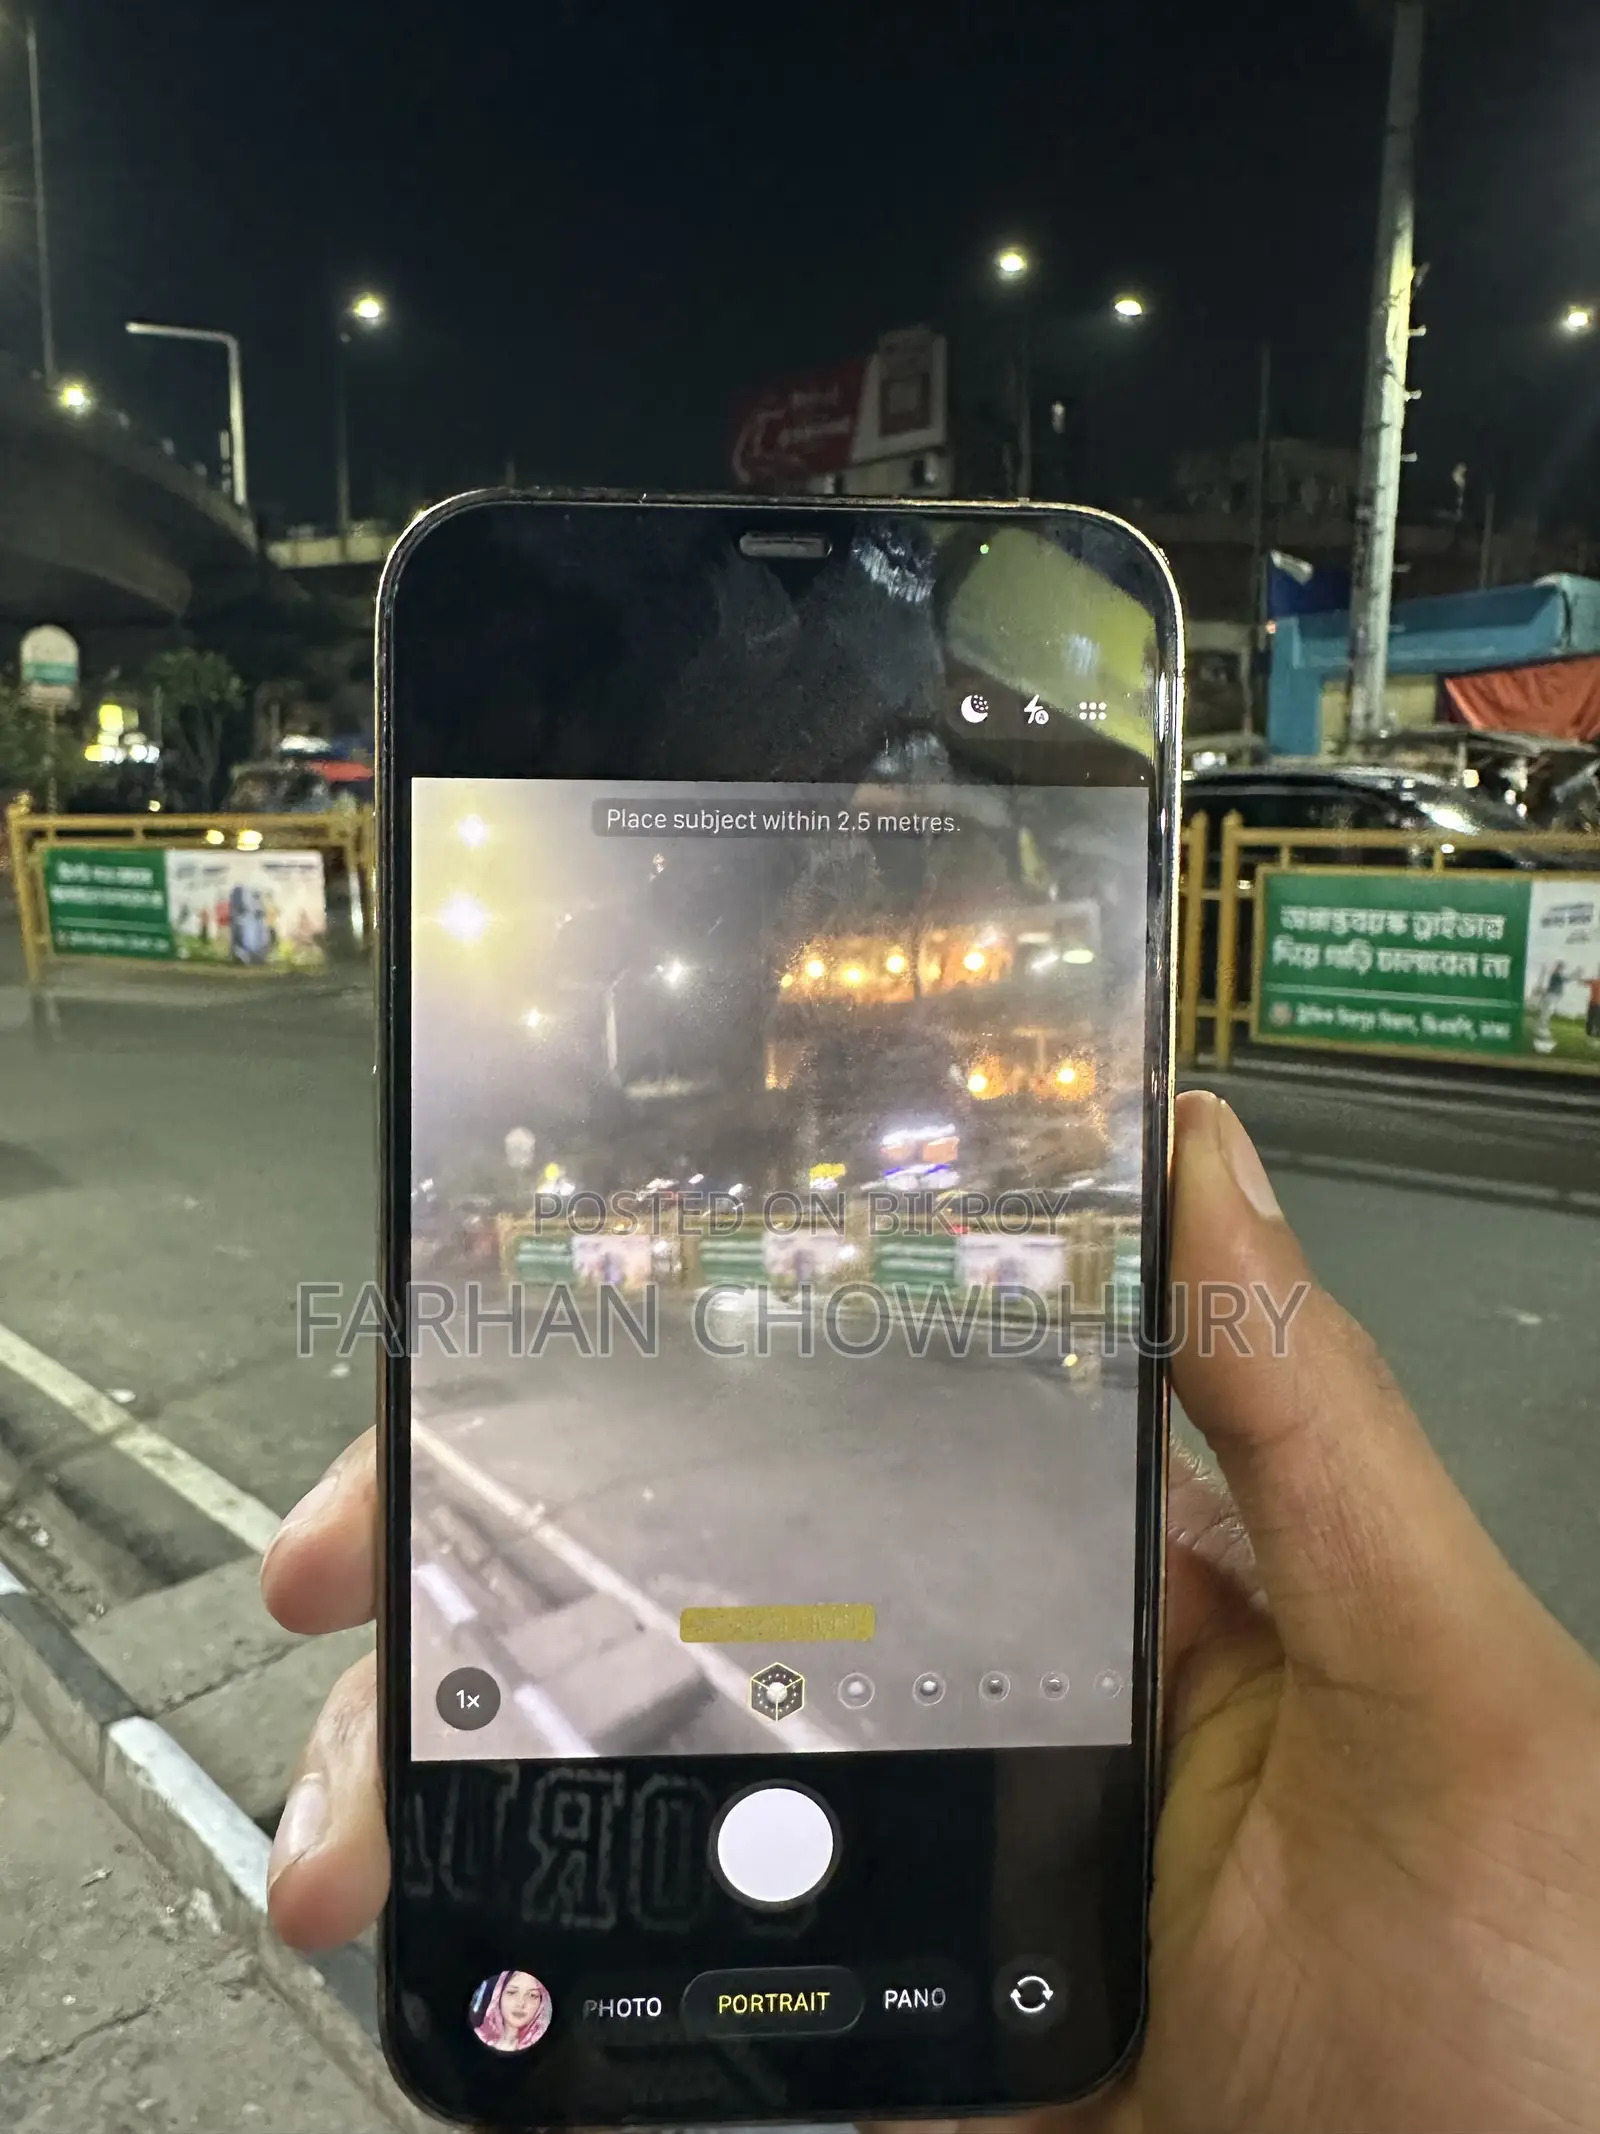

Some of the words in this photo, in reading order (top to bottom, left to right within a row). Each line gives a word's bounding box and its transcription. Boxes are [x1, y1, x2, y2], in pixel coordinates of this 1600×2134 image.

[607, 808, 667, 830] Place
[673, 809, 757, 835] subject
[762, 809, 830, 832] within
[837, 811, 871, 832] 2.5
[877, 812, 961, 833] metres.
[456, 1689, 480, 1709] 1x
[584, 1997, 662, 2018] PHOTO
[718, 1991, 830, 2014] PORTRAIT
[884, 1988, 946, 2010] PANO
